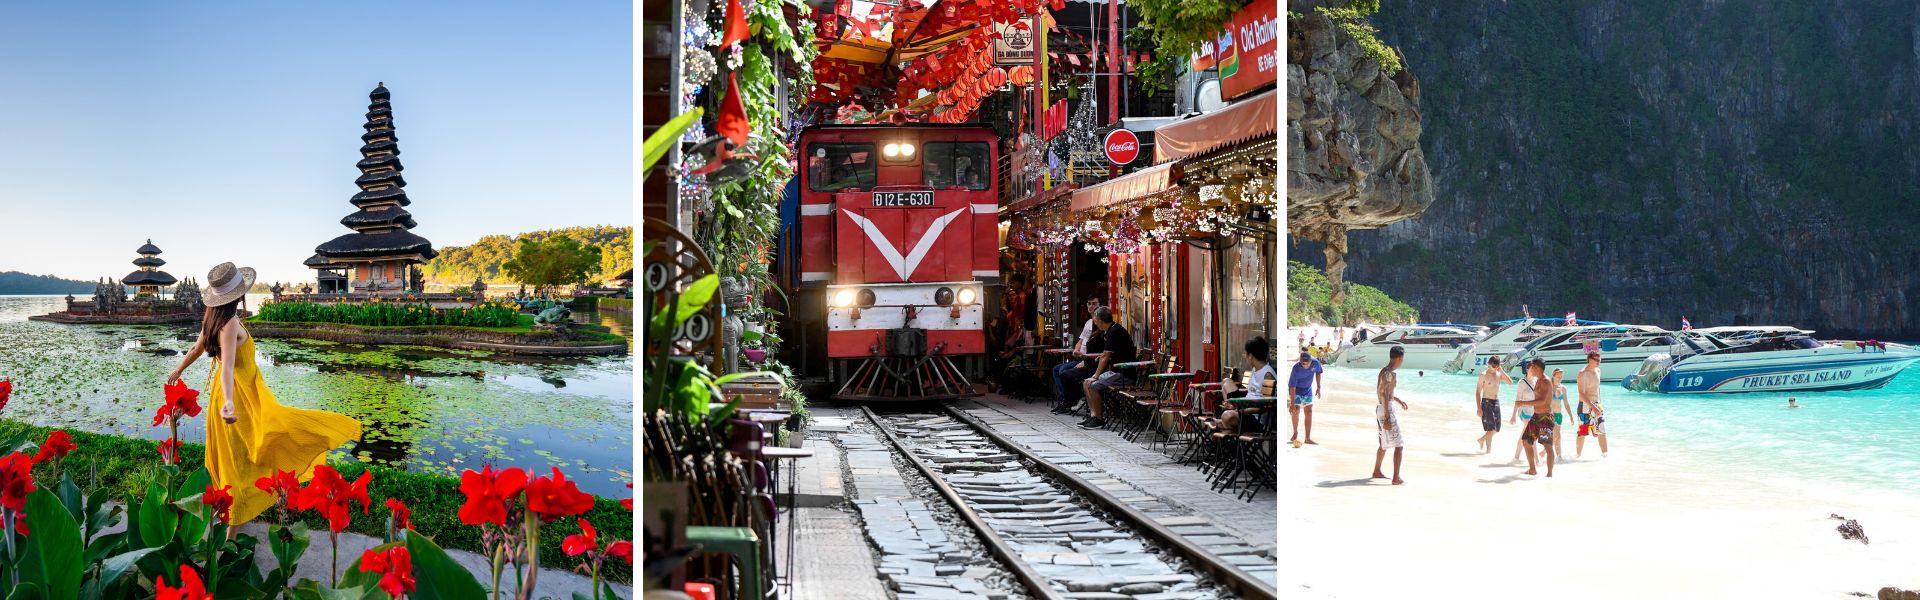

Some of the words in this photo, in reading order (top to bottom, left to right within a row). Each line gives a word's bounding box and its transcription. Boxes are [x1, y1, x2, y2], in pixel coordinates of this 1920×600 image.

[1241, 24, 1255, 53] Old
[1109, 142, 1135, 152] Coca-Cola
[897, 193, 930, 206] E-630
[1677, 375, 1704, 388] 119
[1742, 373, 1791, 388] PHUKET
[1791, 372, 1810, 384] SEA
[1814, 370, 1852, 382] ISLAND
